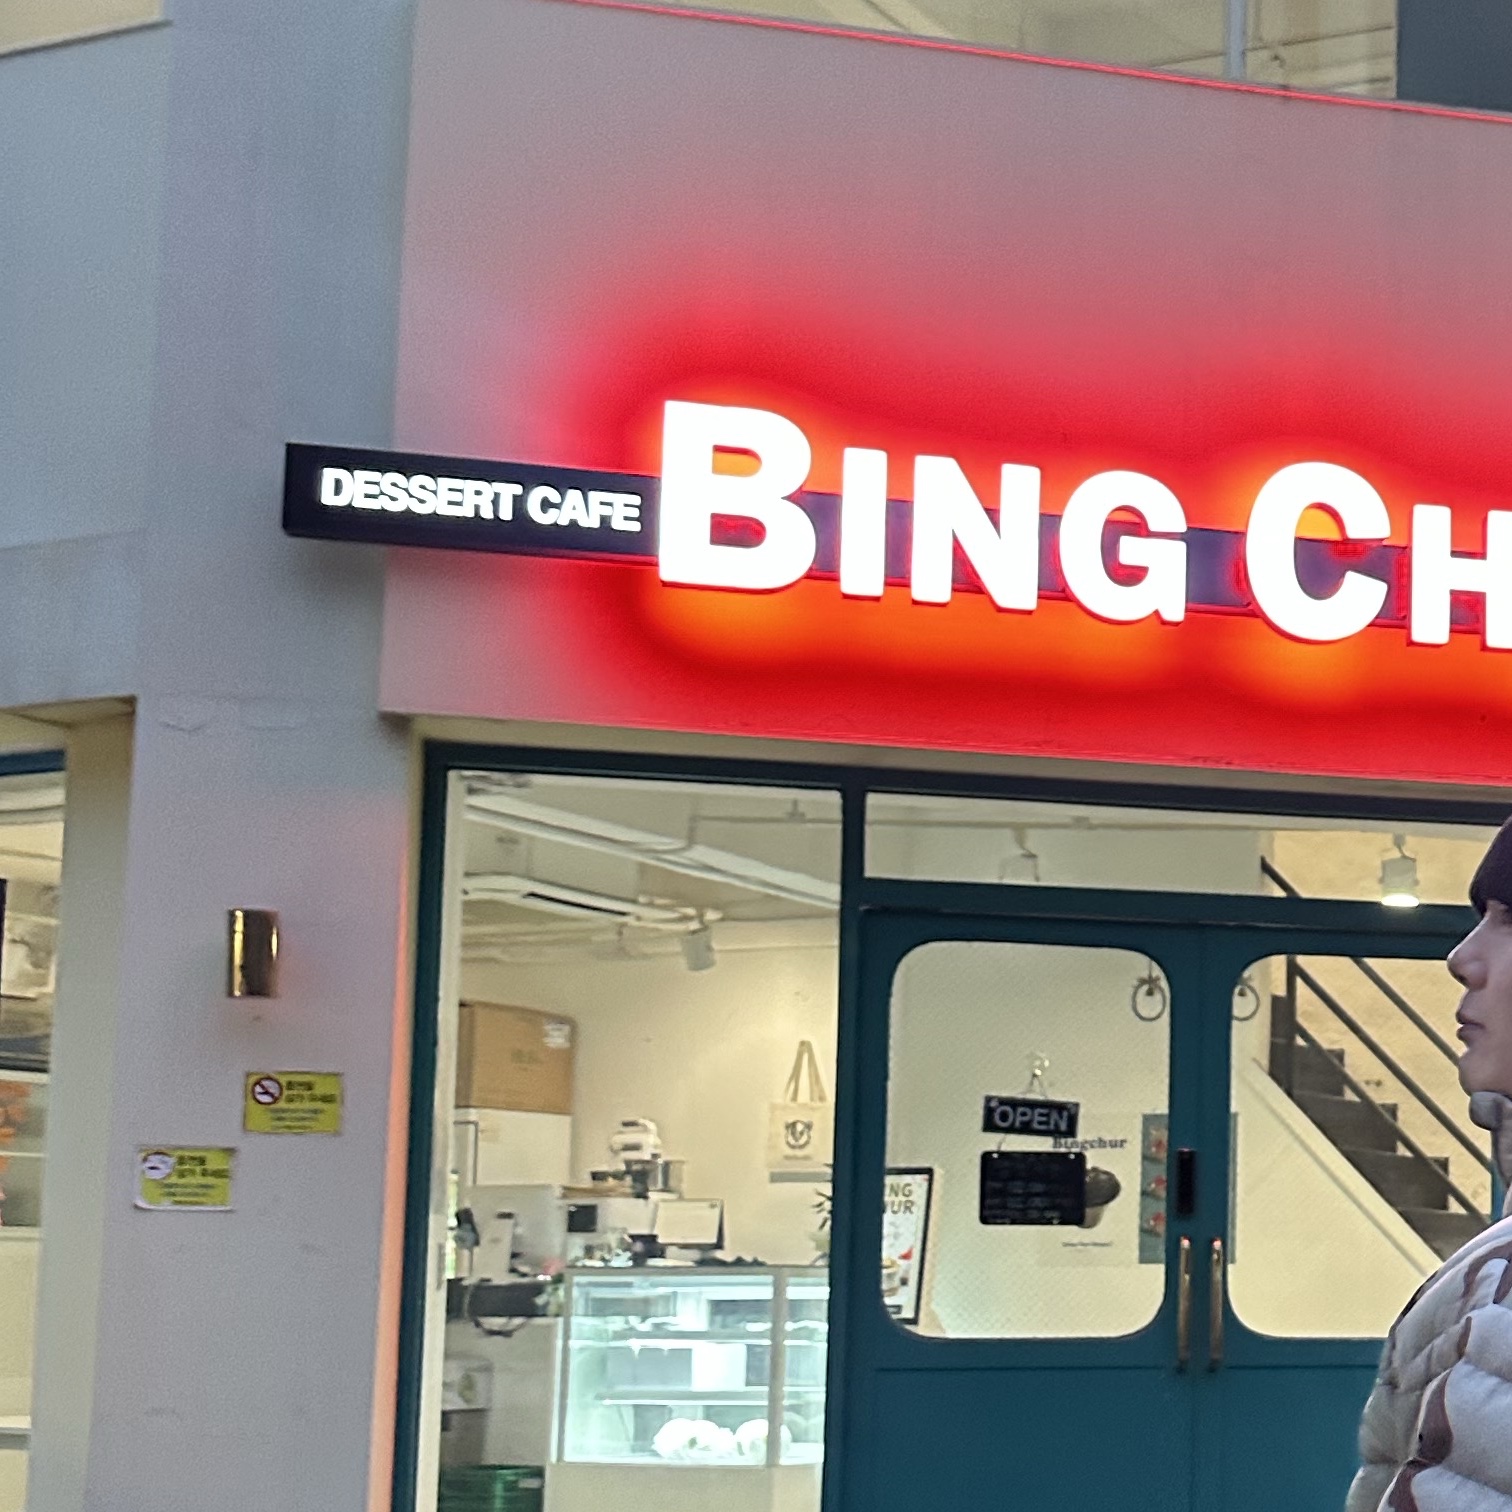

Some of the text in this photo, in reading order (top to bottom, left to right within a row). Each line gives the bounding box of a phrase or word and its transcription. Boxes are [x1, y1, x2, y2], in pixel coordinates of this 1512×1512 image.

[320, 467, 642, 532] DESSERT CAFE
[658, 400, 1188, 625] BING
[994, 1105, 1069, 1132] OPEN
